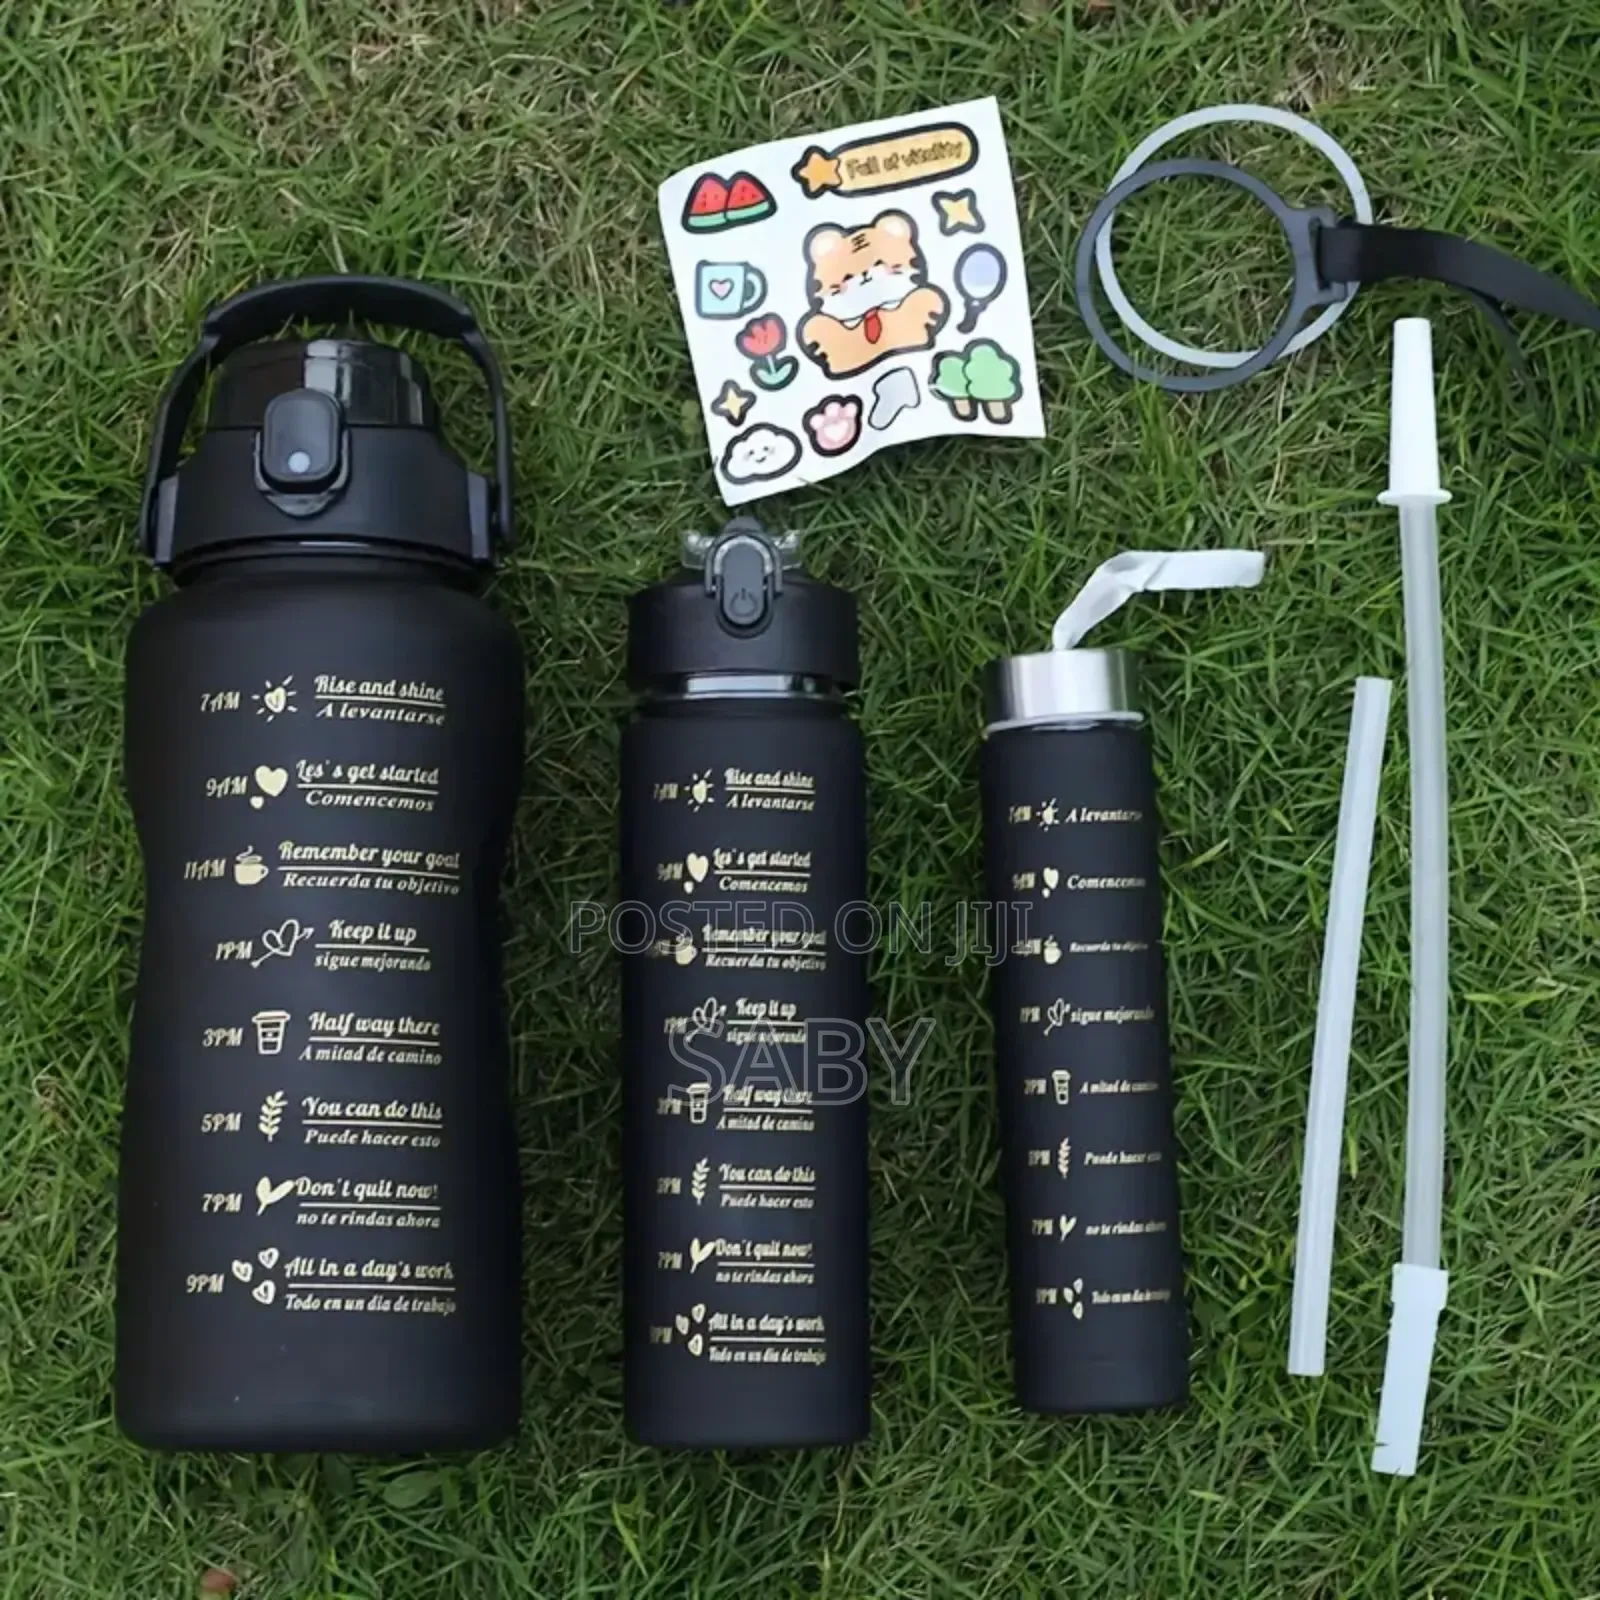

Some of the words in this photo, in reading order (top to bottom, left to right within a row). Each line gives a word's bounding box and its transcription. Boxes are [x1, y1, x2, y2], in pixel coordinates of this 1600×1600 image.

[314, 675, 354, 695] Rise
[359, 678, 395, 697] and
[398, 681, 445, 702] shine
[200, 691, 241, 712] 7AM
[316, 703, 334, 718] A
[340, 703, 445, 726] levantarse
[348, 761, 376, 784] get
[379, 763, 440, 785] started
[754, 770, 781, 787] and
[206, 776, 248, 798] 9AM
[305, 790, 435, 812] Comencemos
[726, 794, 738, 808] A
[741, 793, 815, 811] levantarse
[1065, 808, 1077, 822] A
[279, 840, 379, 862] Remember
[382, 851, 420, 870] your
[425, 851, 460, 869] goal
[747, 850, 766, 870] get
[769, 851, 812, 868] started
[283, 872, 371, 889] Recuerda
[374, 873, 394, 890] tu
[397, 875, 459, 896] objetivo
[719, 876, 808, 893] Comencemos
[328, 919, 374, 944] Keep
[377, 922, 393, 941] it
[397, 927, 417, 945] up
[215, 941, 252, 961] 1PM
[705, 953, 765, 968] Recuerda
[314, 952, 359, 971] sigue
[359, 954, 431, 974] mejorando
[309, 1010, 354, 1036] Half
[356, 1018, 395, 1038] way
[397, 1015, 441, 1036] there
[203, 1028, 244, 1048] 3PM
[299, 1046, 312, 1061] A
[315, 1045, 363, 1062] mitad
[367, 1046, 385, 1063] de
[387, 1049, 442, 1066] camino
[301, 1097, 341, 1117] You
[345, 1103, 382, 1118] can
[383, 1100, 408, 1119] do
[410, 1101, 443, 1121] this
[201, 1112, 242, 1133] 5PM
[716, 1116, 726, 1130] A
[304, 1129, 359, 1146] Puede
[361, 1130, 408, 1147] hacer
[410, 1133, 441, 1149] esto
[719, 1164, 745, 1181] You
[747, 1167, 772, 1182] can
[774, 1165, 790, 1182] do
[792, 1166, 815, 1182] this
[296, 1176, 350, 1198] Don't
[353, 1180, 393, 1202] quit
[202, 1194, 242, 1213] 7PM
[296, 1212, 319, 1225] no
[321, 1211, 337, 1226] te
[339, 1210, 393, 1227] rindas
[396, 1212, 441, 1229] ahora
[284, 1256, 316, 1279] All
[319, 1258, 340, 1277] in
[342, 1261, 358, 1278] a
[360, 1259, 411, 1283] day's
[414, 1261, 455, 1279] work
[186, 1274, 225, 1294] 9PM
[285, 1293, 321, 1311] Todo
[323, 1297, 342, 1311] en
[344, 1297, 364, 1311] un
[393, 1294, 411, 1312] de
[412, 1296, 456, 1317] trabajo
[708, 1312, 729, 1332] All
[730, 1313, 745, 1331] in
[746, 1317, 758, 1331] a
